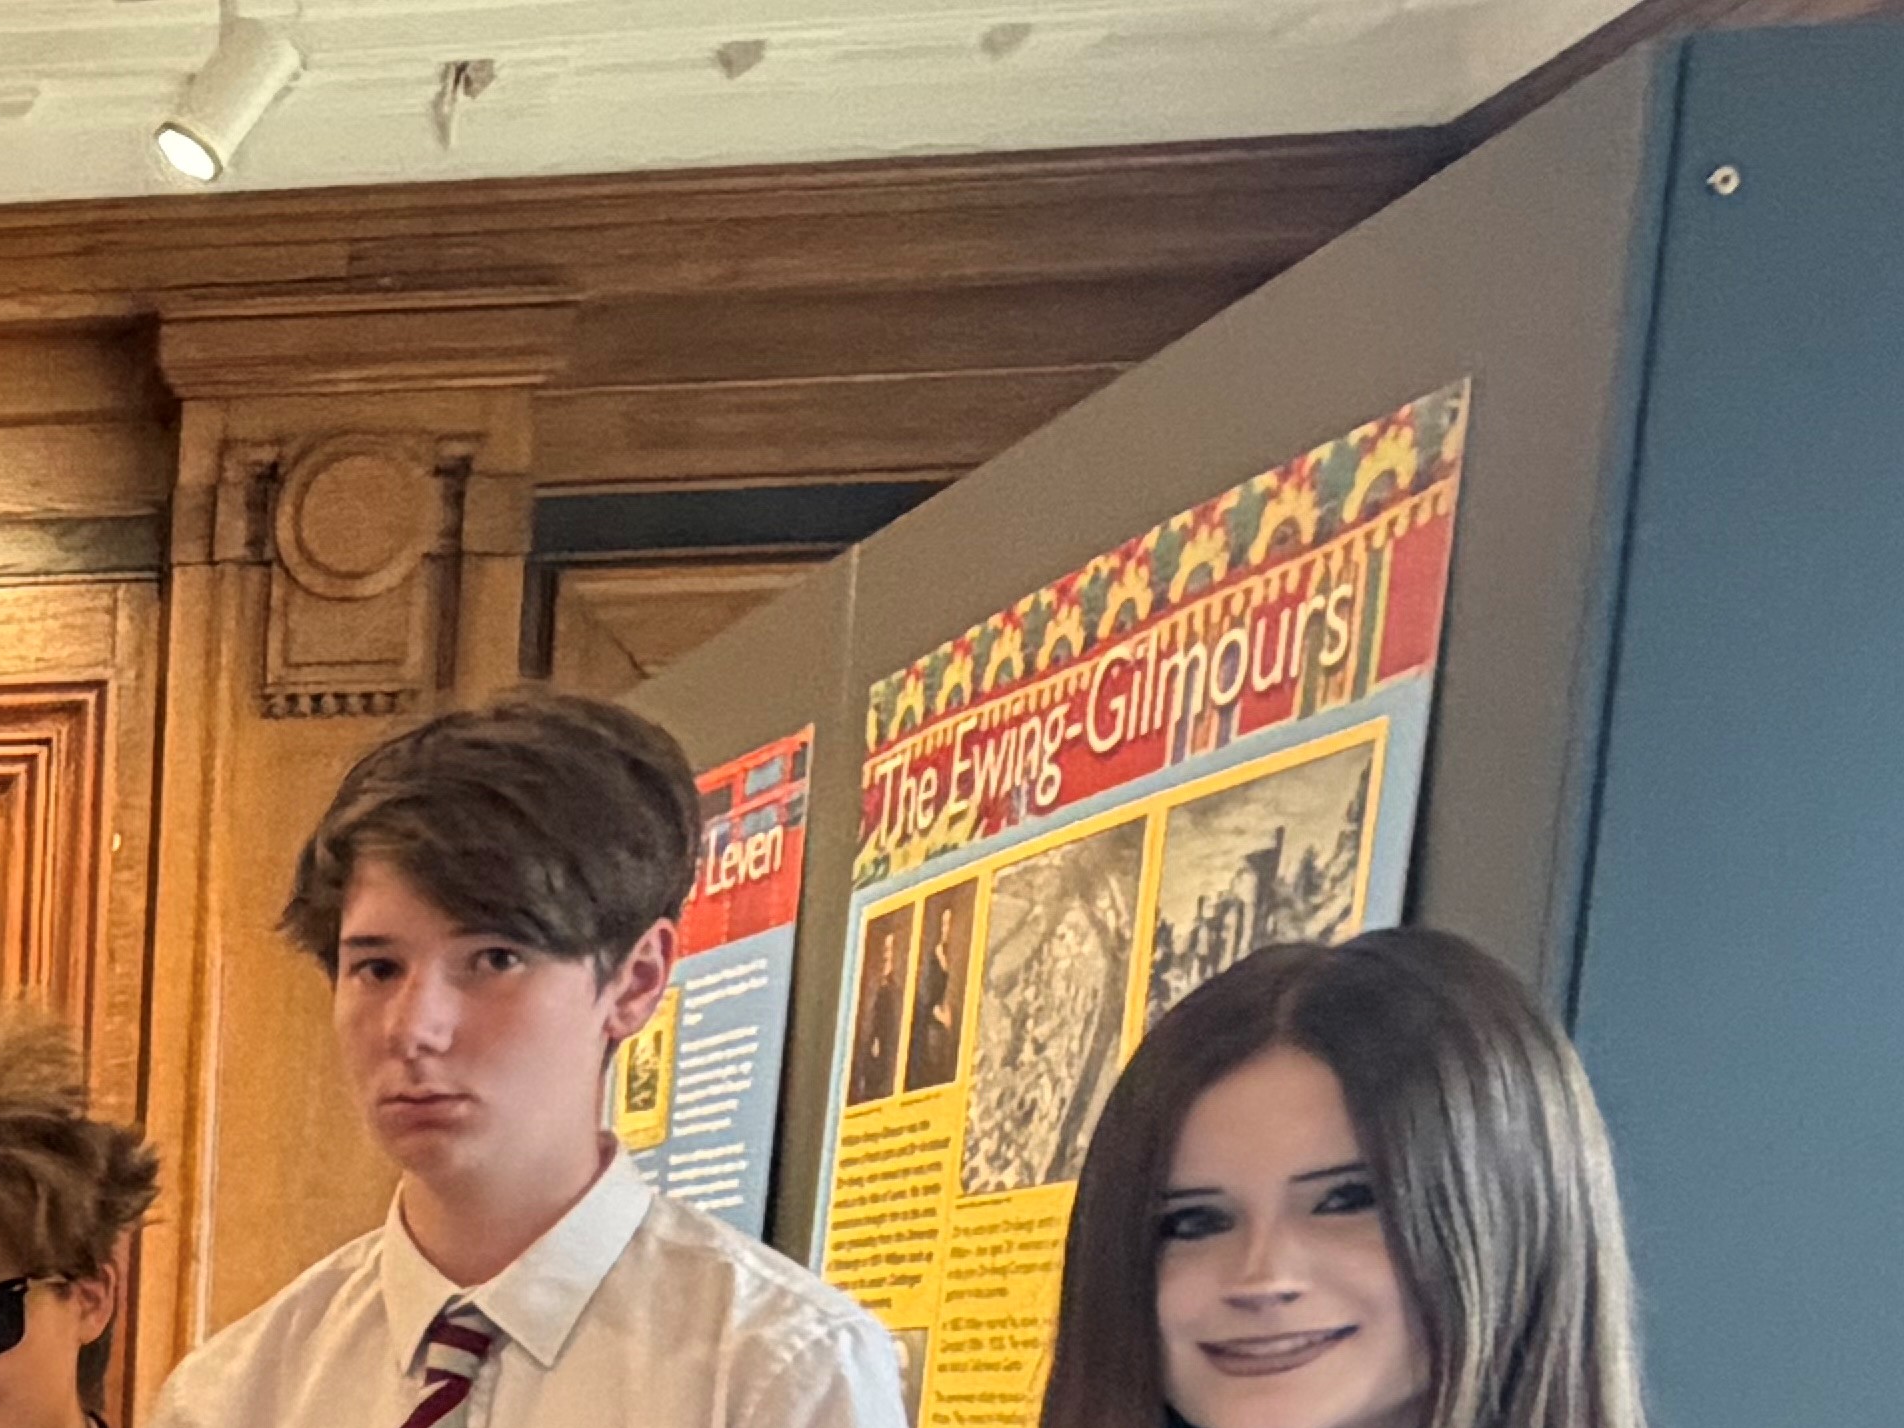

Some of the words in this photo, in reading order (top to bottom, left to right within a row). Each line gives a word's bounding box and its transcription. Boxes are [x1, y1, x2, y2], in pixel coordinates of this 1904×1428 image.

[877, 750, 938, 847] The
[949, 583, 1353, 815] Ewing-Gilmours
[706, 826, 783, 896] Leven
